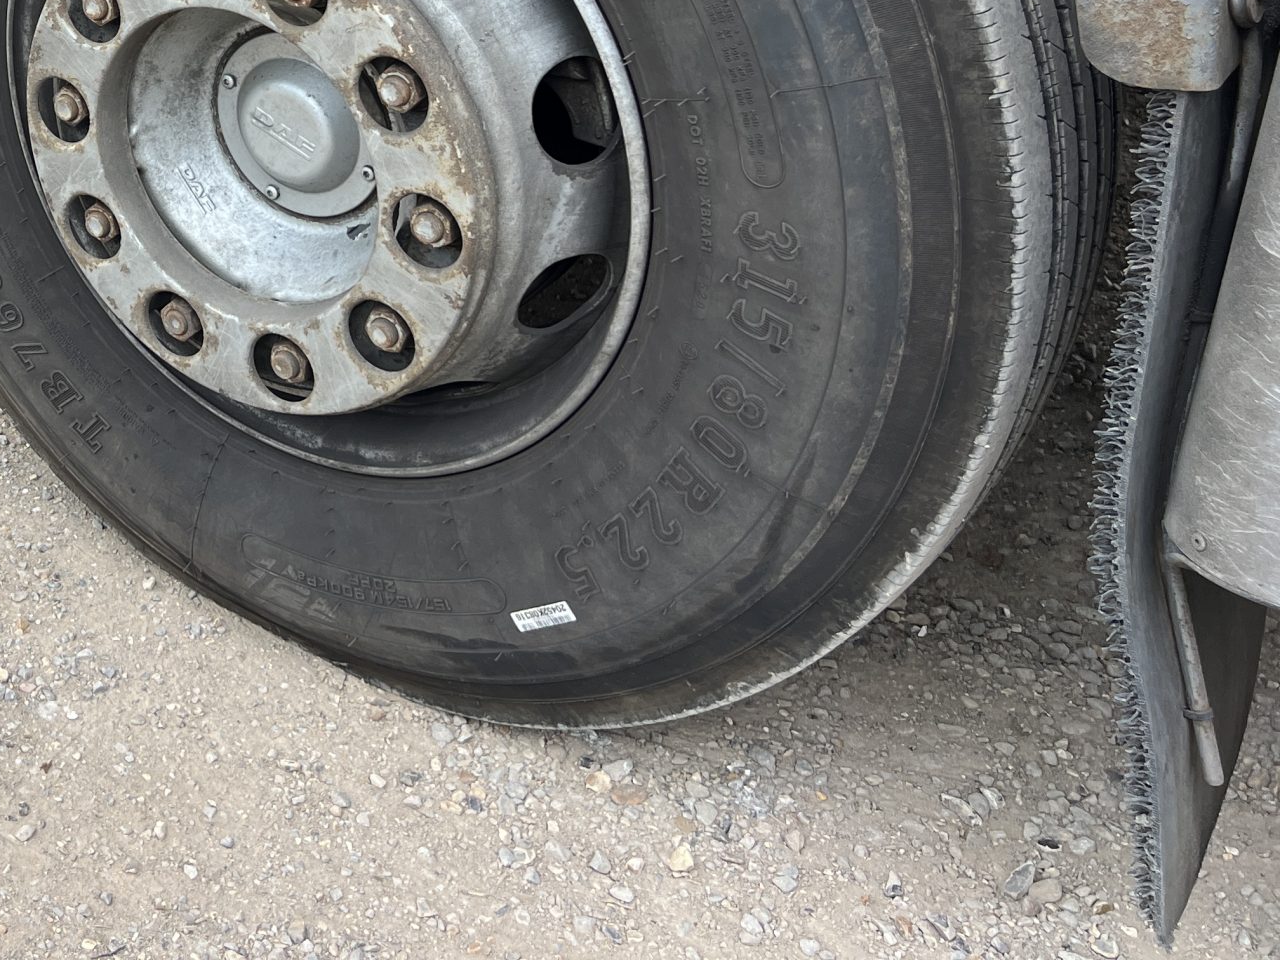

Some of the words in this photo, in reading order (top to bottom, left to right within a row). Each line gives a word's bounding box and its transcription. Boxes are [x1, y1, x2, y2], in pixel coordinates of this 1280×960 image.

[251, 105, 317, 154] DAF
[687, 112, 705, 146] DOT
[183, 161, 217, 214] DAF
[553, 210, 801, 602] 315/80R22.5
